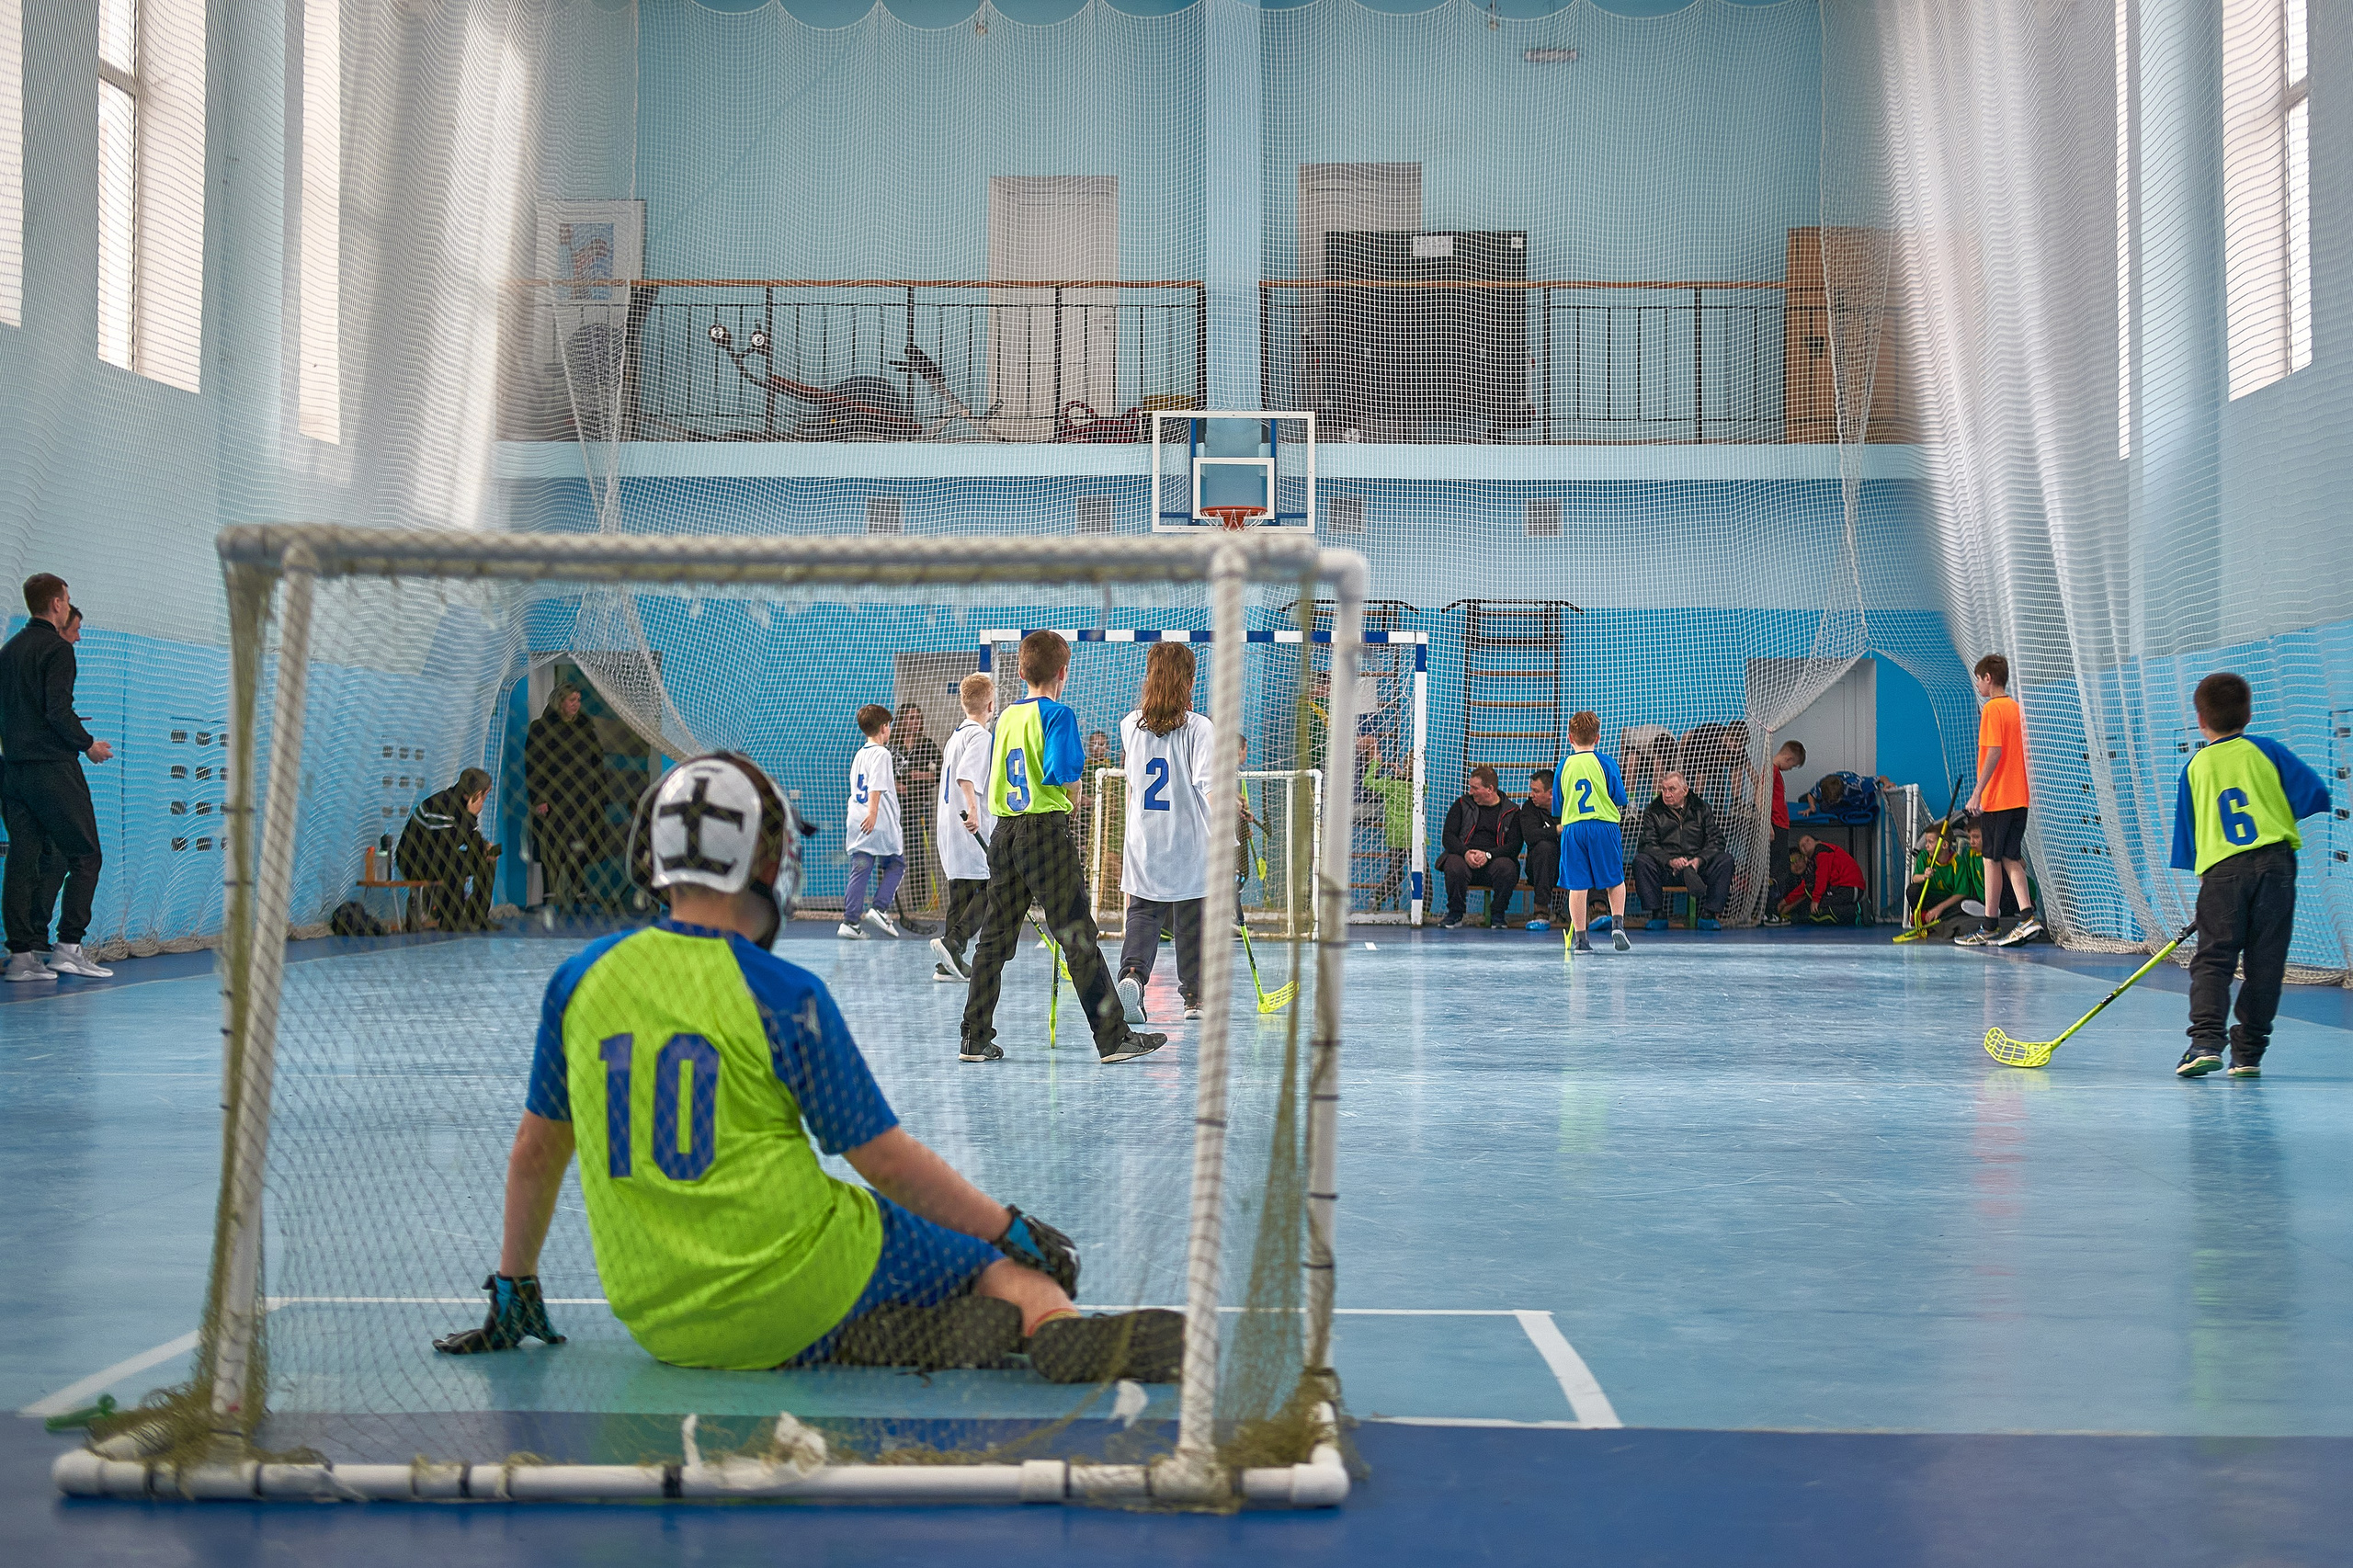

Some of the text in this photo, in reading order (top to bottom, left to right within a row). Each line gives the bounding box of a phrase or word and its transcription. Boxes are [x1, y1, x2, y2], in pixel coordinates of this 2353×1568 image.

[856, 773, 869, 805] 5
[1006, 747, 1031, 812] 9
[1143, 757, 1170, 812] 2
[1574, 778, 1594, 814] 2
[2217, 788, 2259, 846] 6
[598, 1032, 720, 1182] 10
